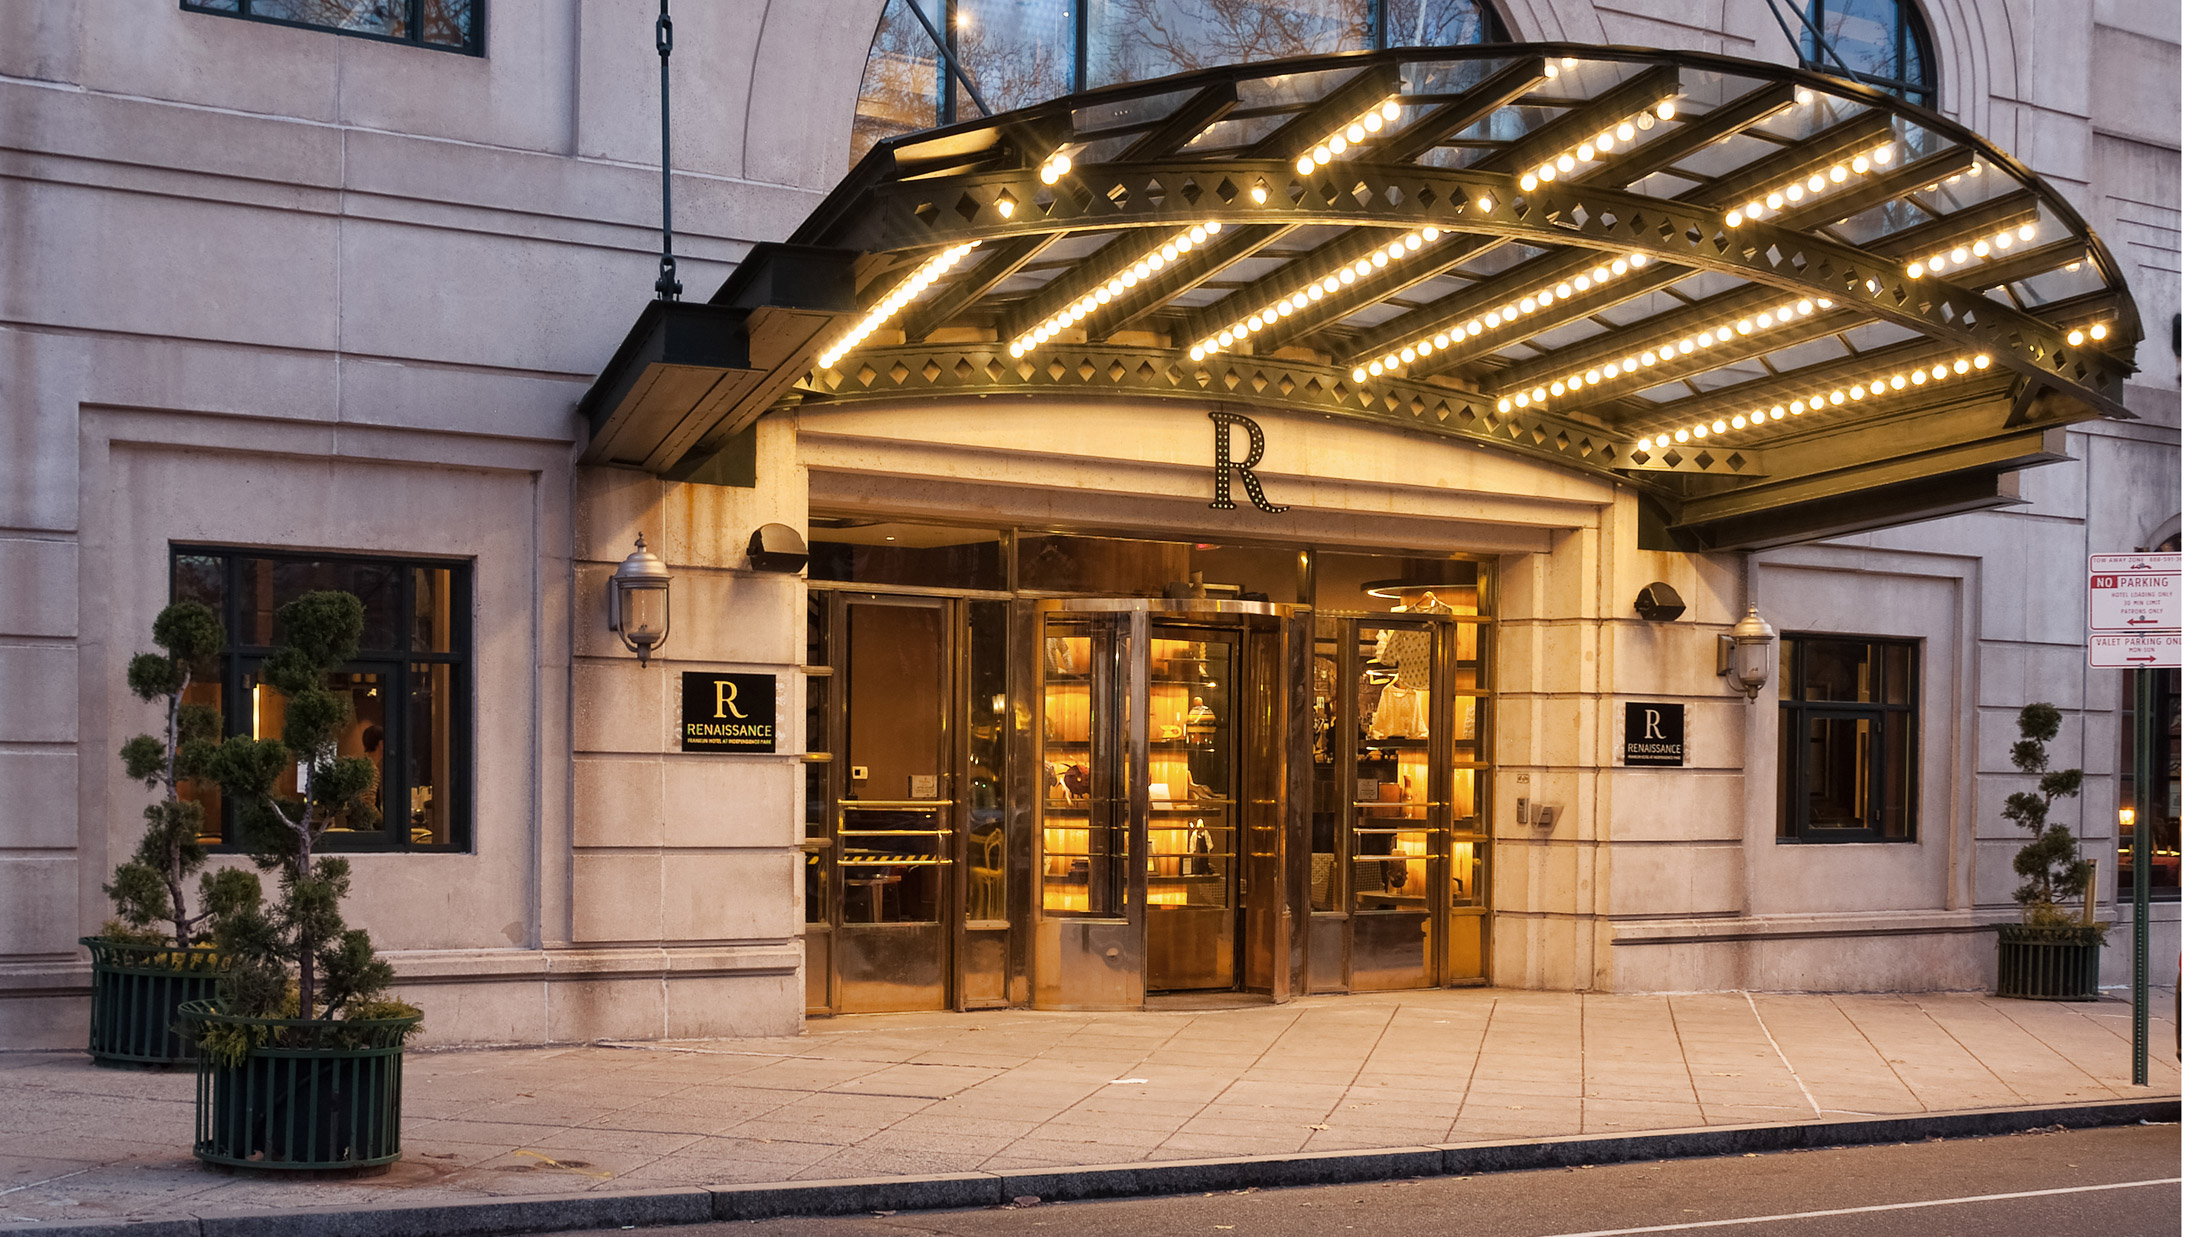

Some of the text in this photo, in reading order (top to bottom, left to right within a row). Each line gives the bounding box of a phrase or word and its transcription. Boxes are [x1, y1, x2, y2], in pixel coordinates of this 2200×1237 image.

[1208, 412, 1290, 513] R
[2096, 577, 2169, 588] NO PARKING
[2096, 638, 2121, 646] VALET
[2124, 638, 2162, 646] PARKING
[713, 680, 749, 718] R
[687, 723, 772, 736] RENAISSANCE
[1644, 709, 1667, 740] R
[1627, 743, 1682, 754] RENAISSANCE
